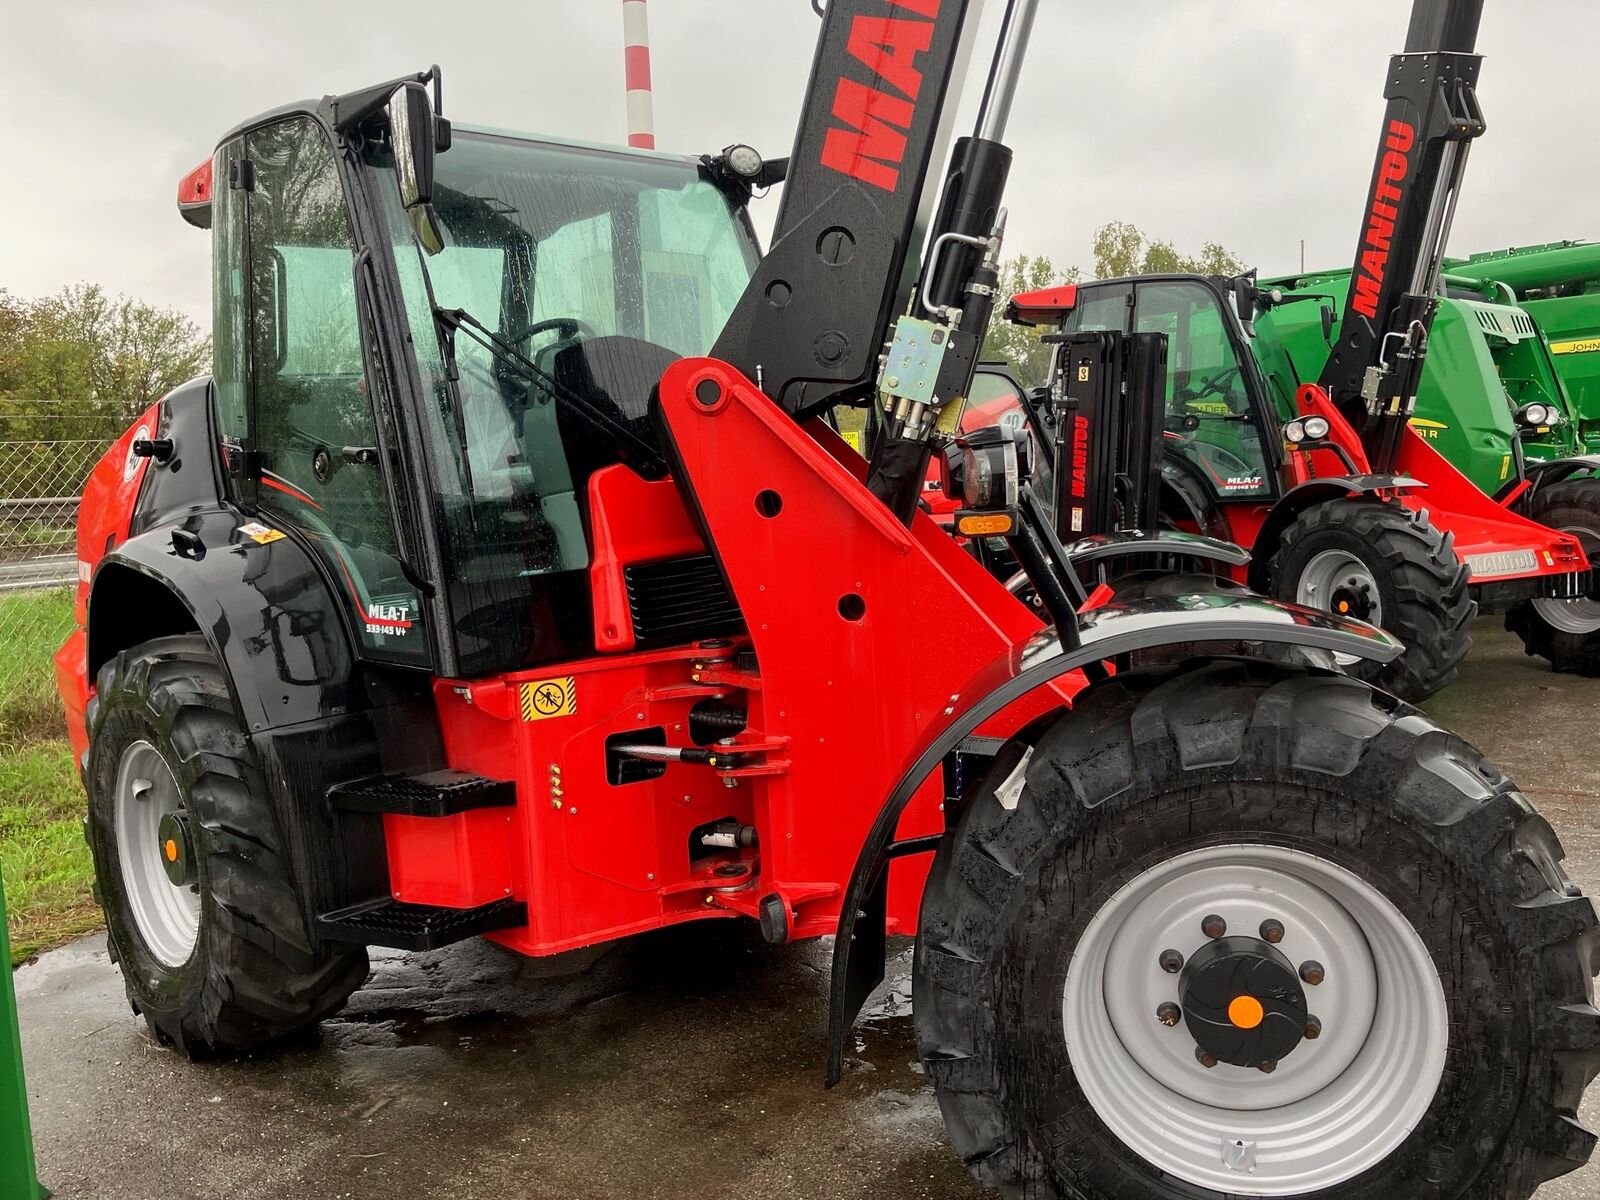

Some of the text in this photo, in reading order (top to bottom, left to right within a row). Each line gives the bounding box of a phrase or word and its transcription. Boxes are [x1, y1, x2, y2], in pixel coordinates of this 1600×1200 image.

[1352, 120, 1414, 319] MANITOU
[1569, 342, 1600, 352] JOHN
[1429, 429, 1438, 439] R
[1072, 416, 1089, 498] MANITOU
[1469, 550, 1537, 575] MANITOU
[395, 626, 407, 637] V+
